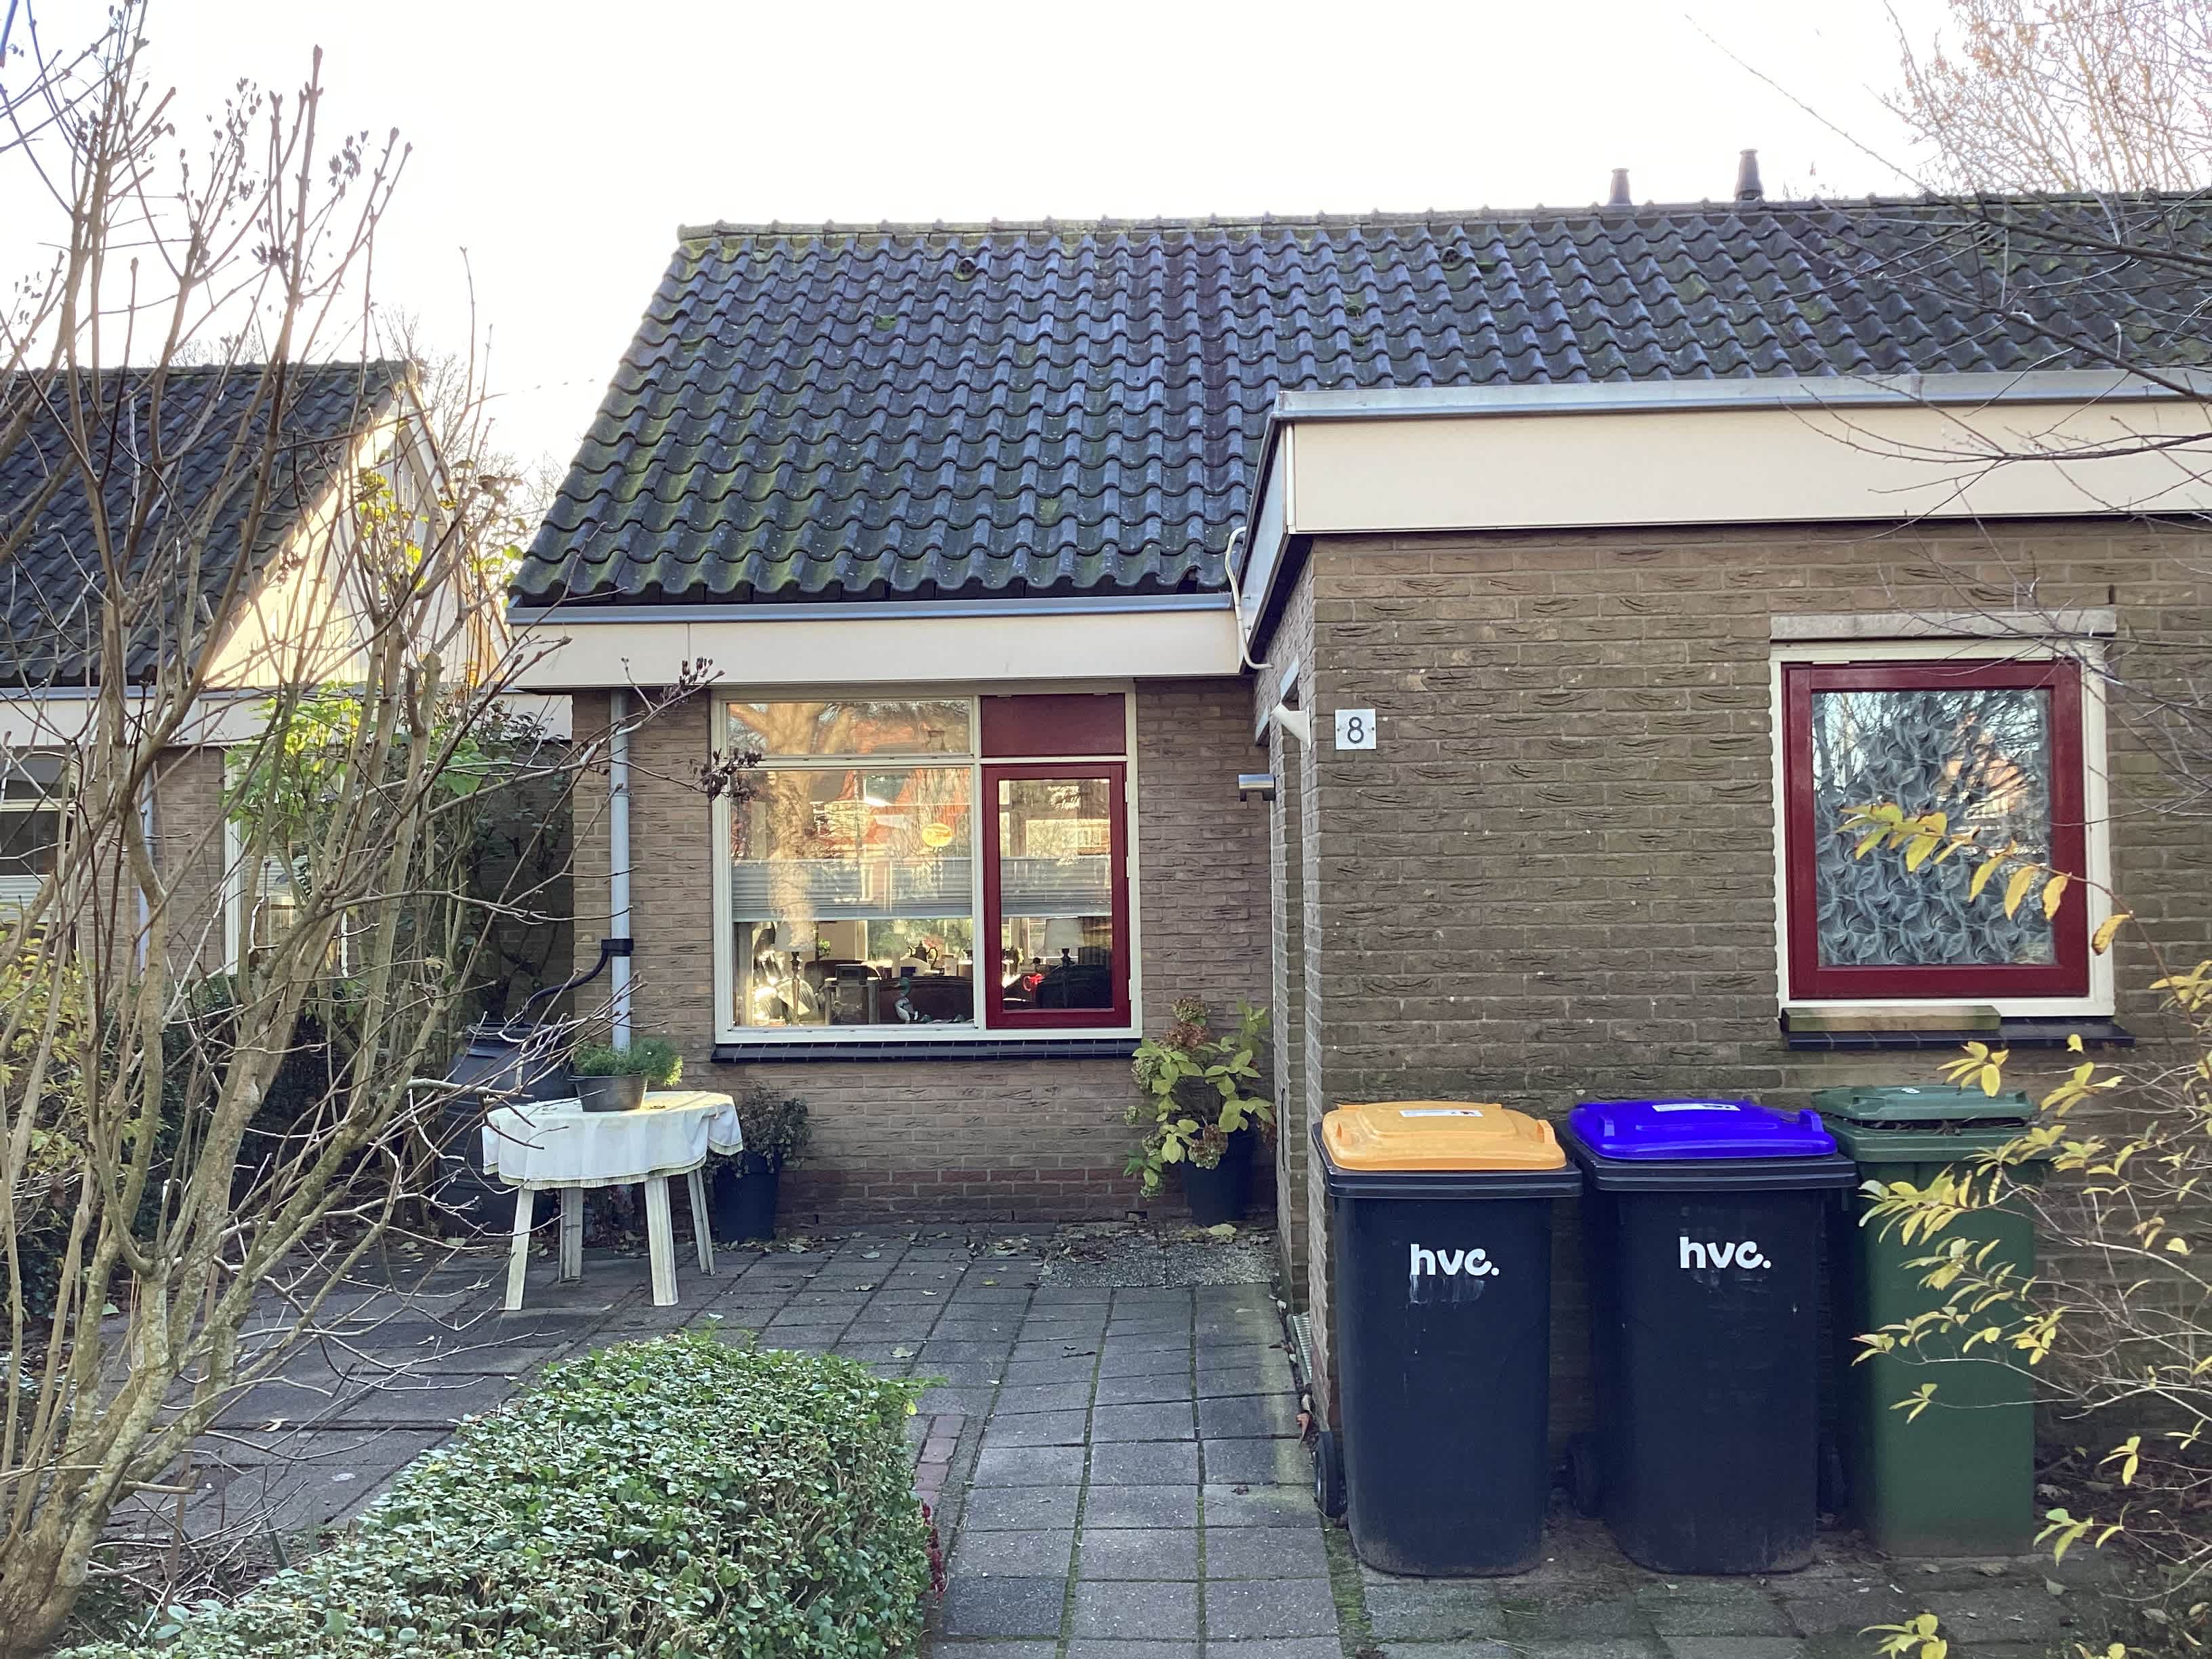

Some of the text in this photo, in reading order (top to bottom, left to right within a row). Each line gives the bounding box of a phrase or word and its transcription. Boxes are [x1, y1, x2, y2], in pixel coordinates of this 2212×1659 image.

[1347, 716, 1364, 743] 8
[1410, 1244, 1500, 1277] hvc.
[1680, 1236, 1771, 1269] hvc.
